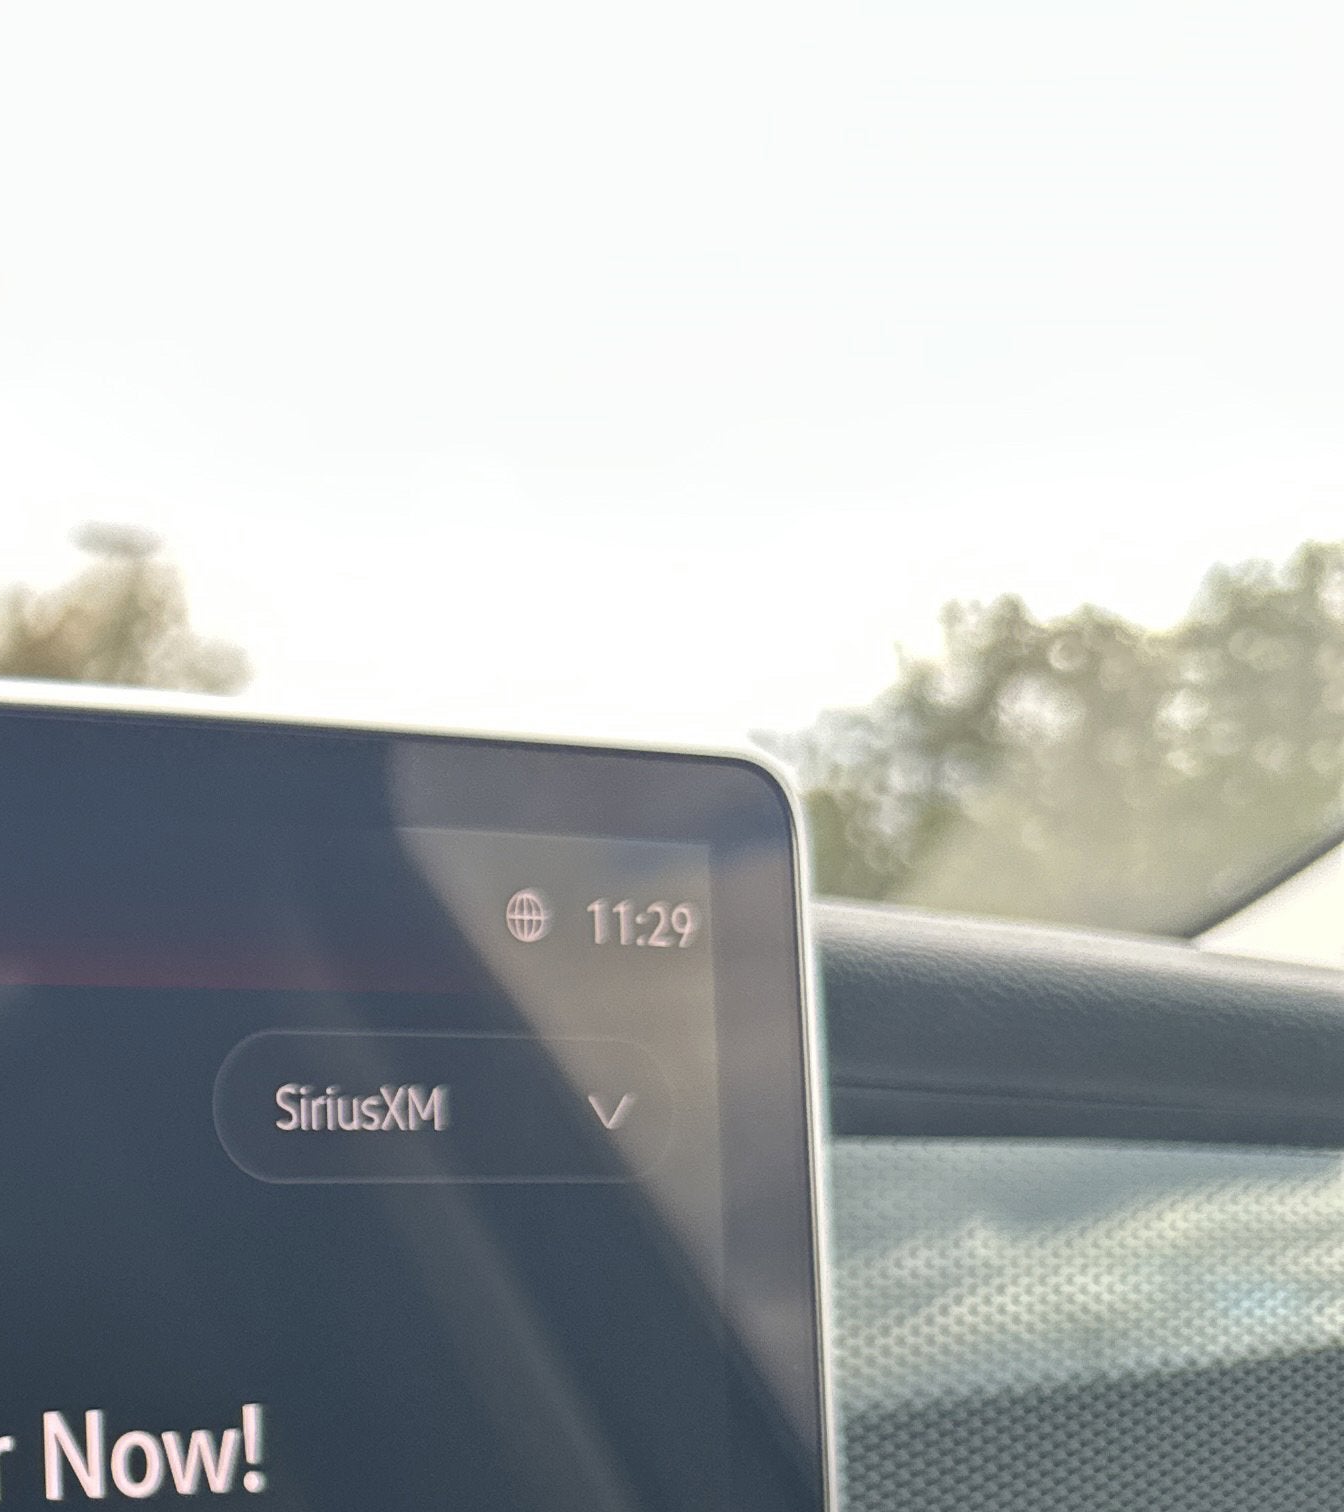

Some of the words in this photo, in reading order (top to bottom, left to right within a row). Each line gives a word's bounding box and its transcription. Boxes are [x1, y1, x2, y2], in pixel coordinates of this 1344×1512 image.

[587, 899, 701, 949] 11:29
[275, 1083, 449, 1132] SiriusXM
[43, 1403, 268, 1502] Now!
